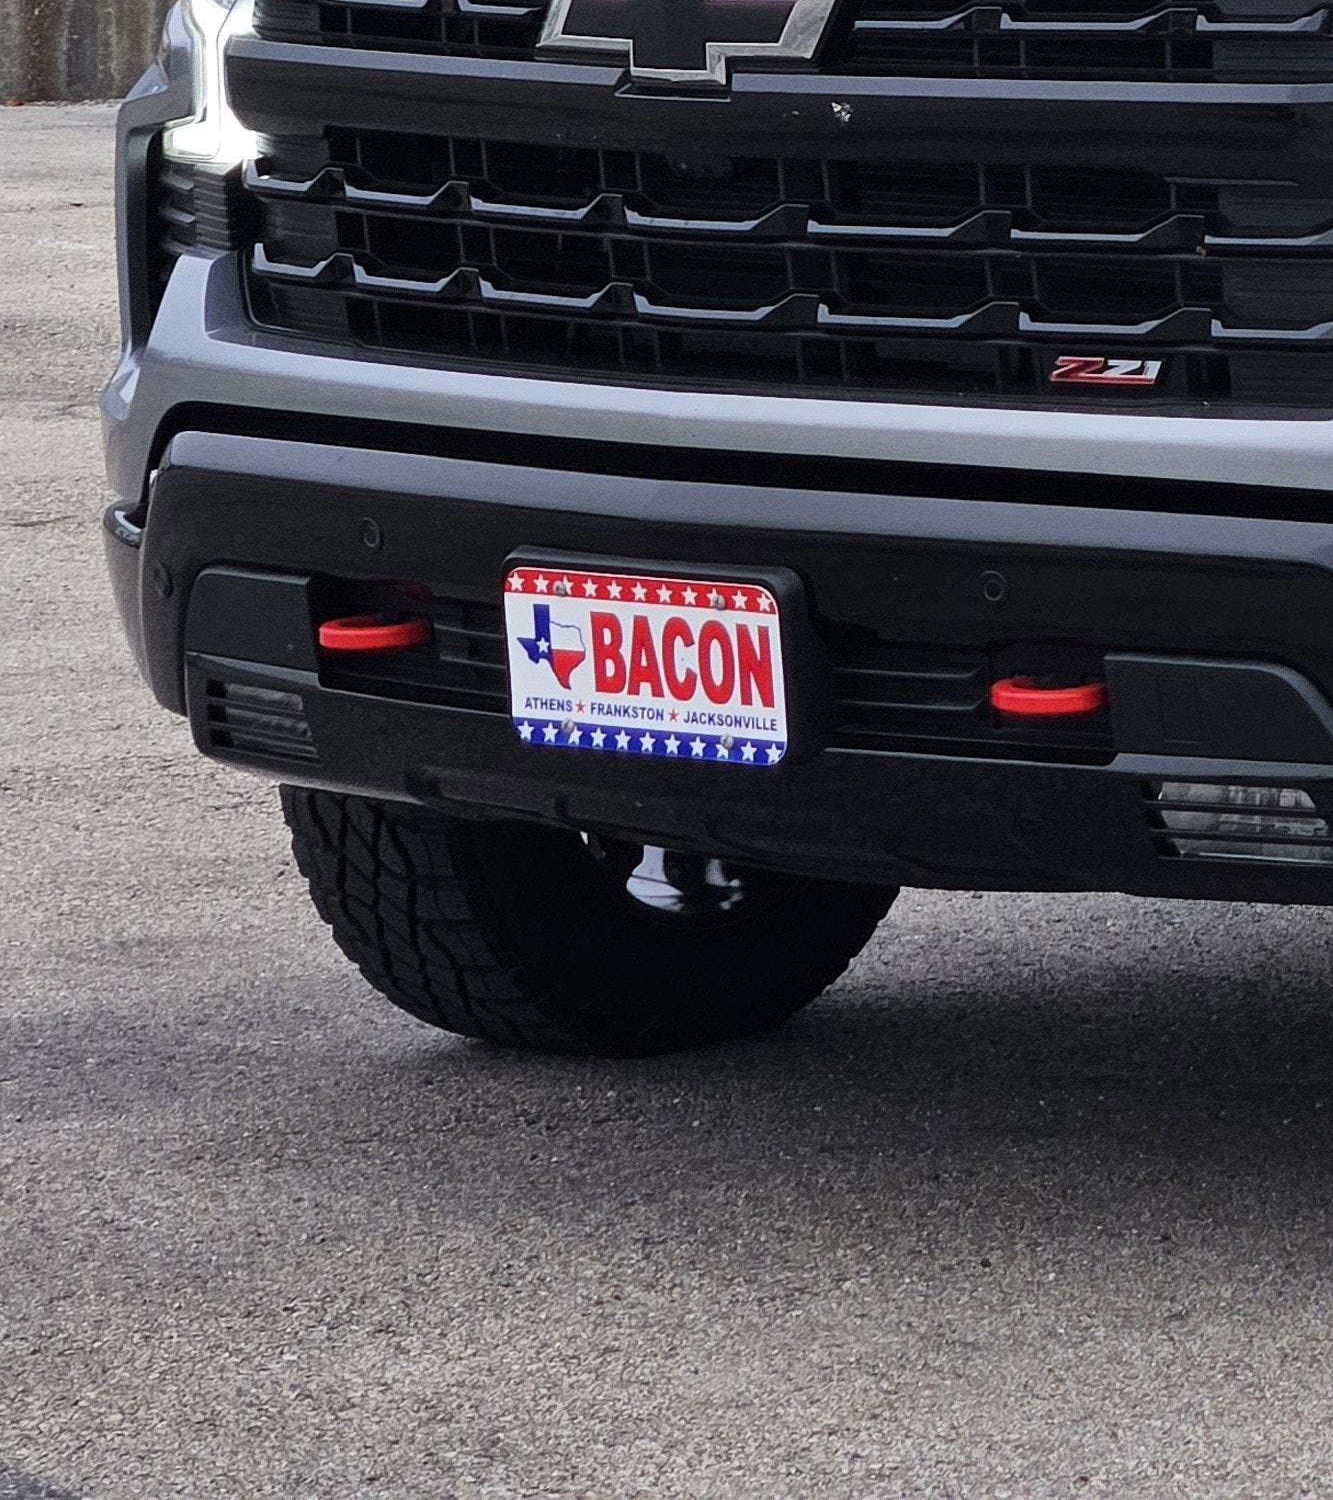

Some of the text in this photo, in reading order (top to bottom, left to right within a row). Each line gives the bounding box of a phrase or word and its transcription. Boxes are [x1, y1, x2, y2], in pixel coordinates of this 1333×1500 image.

[1049, 356, 1163, 385] Z71
[589, 610, 776, 709] BACON
[524, 696, 778, 732] ATHENS FRANKSTON JACKSONVILLE
